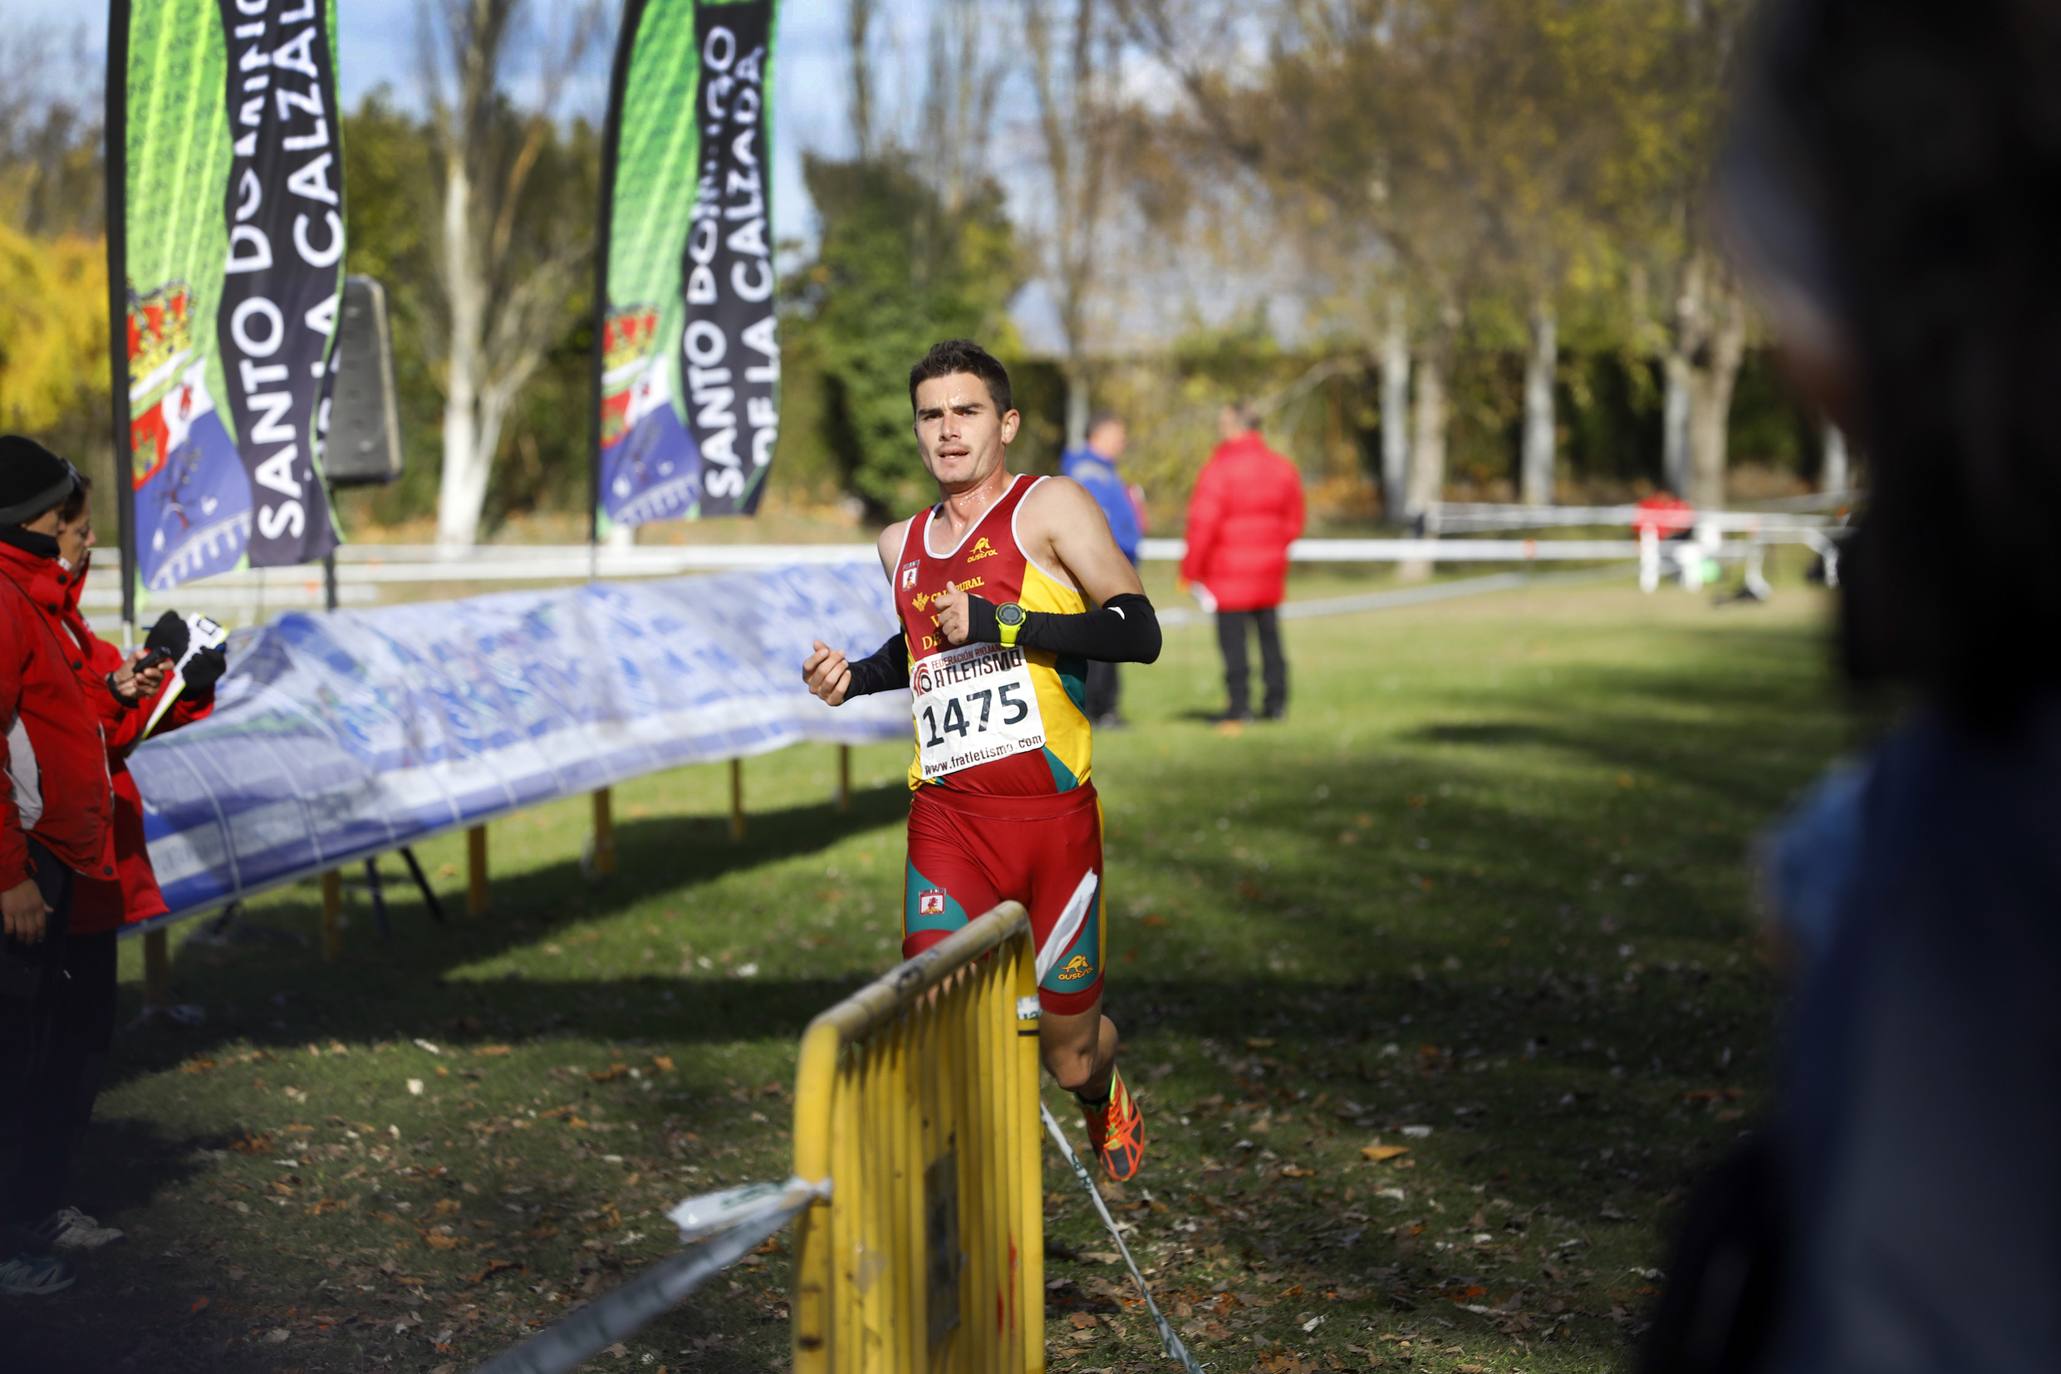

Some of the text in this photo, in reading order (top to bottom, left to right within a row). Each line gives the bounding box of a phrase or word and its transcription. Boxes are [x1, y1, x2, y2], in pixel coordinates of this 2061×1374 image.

[724, 46, 775, 301] CALZADA
[684, 320, 745, 498] SANTO
[741, 315, 781, 382] LA
[231, 296, 305, 540] SANTO
[922, 681, 1029, 748] 1475
[933, 649, 1023, 688] ATLETISMO
